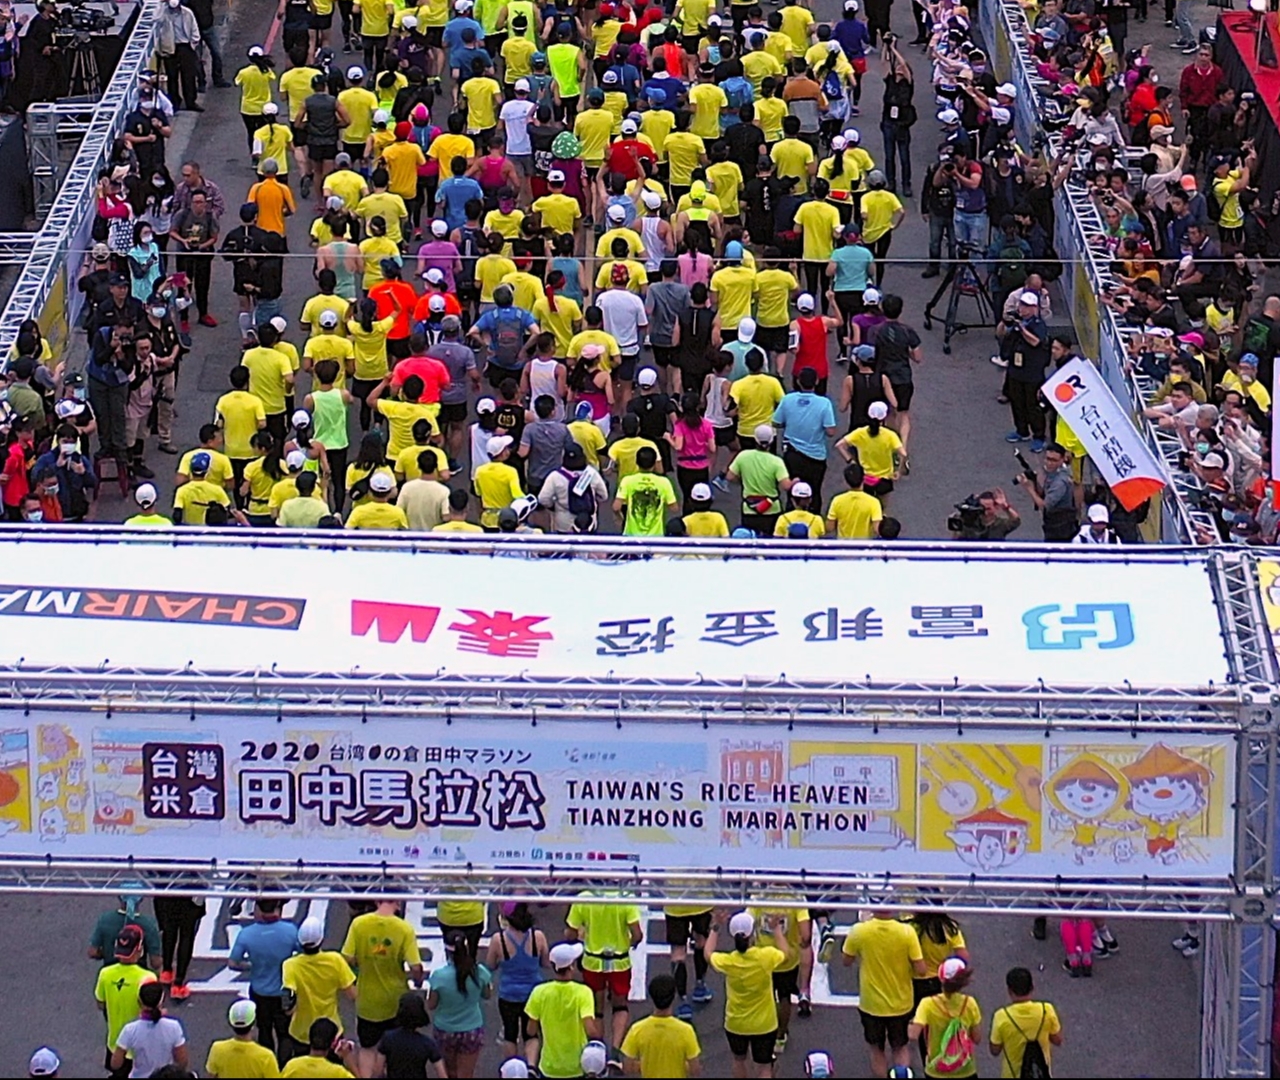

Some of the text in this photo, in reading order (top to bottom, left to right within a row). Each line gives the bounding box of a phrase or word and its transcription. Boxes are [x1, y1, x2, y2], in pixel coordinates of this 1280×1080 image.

[1078, 402, 1138, 479] 台中精機
[350, 599, 555, 658] 泰山
[595, 604, 989, 658] 富邦金控
[150, 748, 219, 781] 台灣
[150, 784, 219, 817] 米倉
[237, 765, 547, 831] 田中馬拉松
[565, 779, 870, 806] TAIWAN'S RICE HEAVEN
[567, 807, 870, 833] TIANZHONG MARATHON
